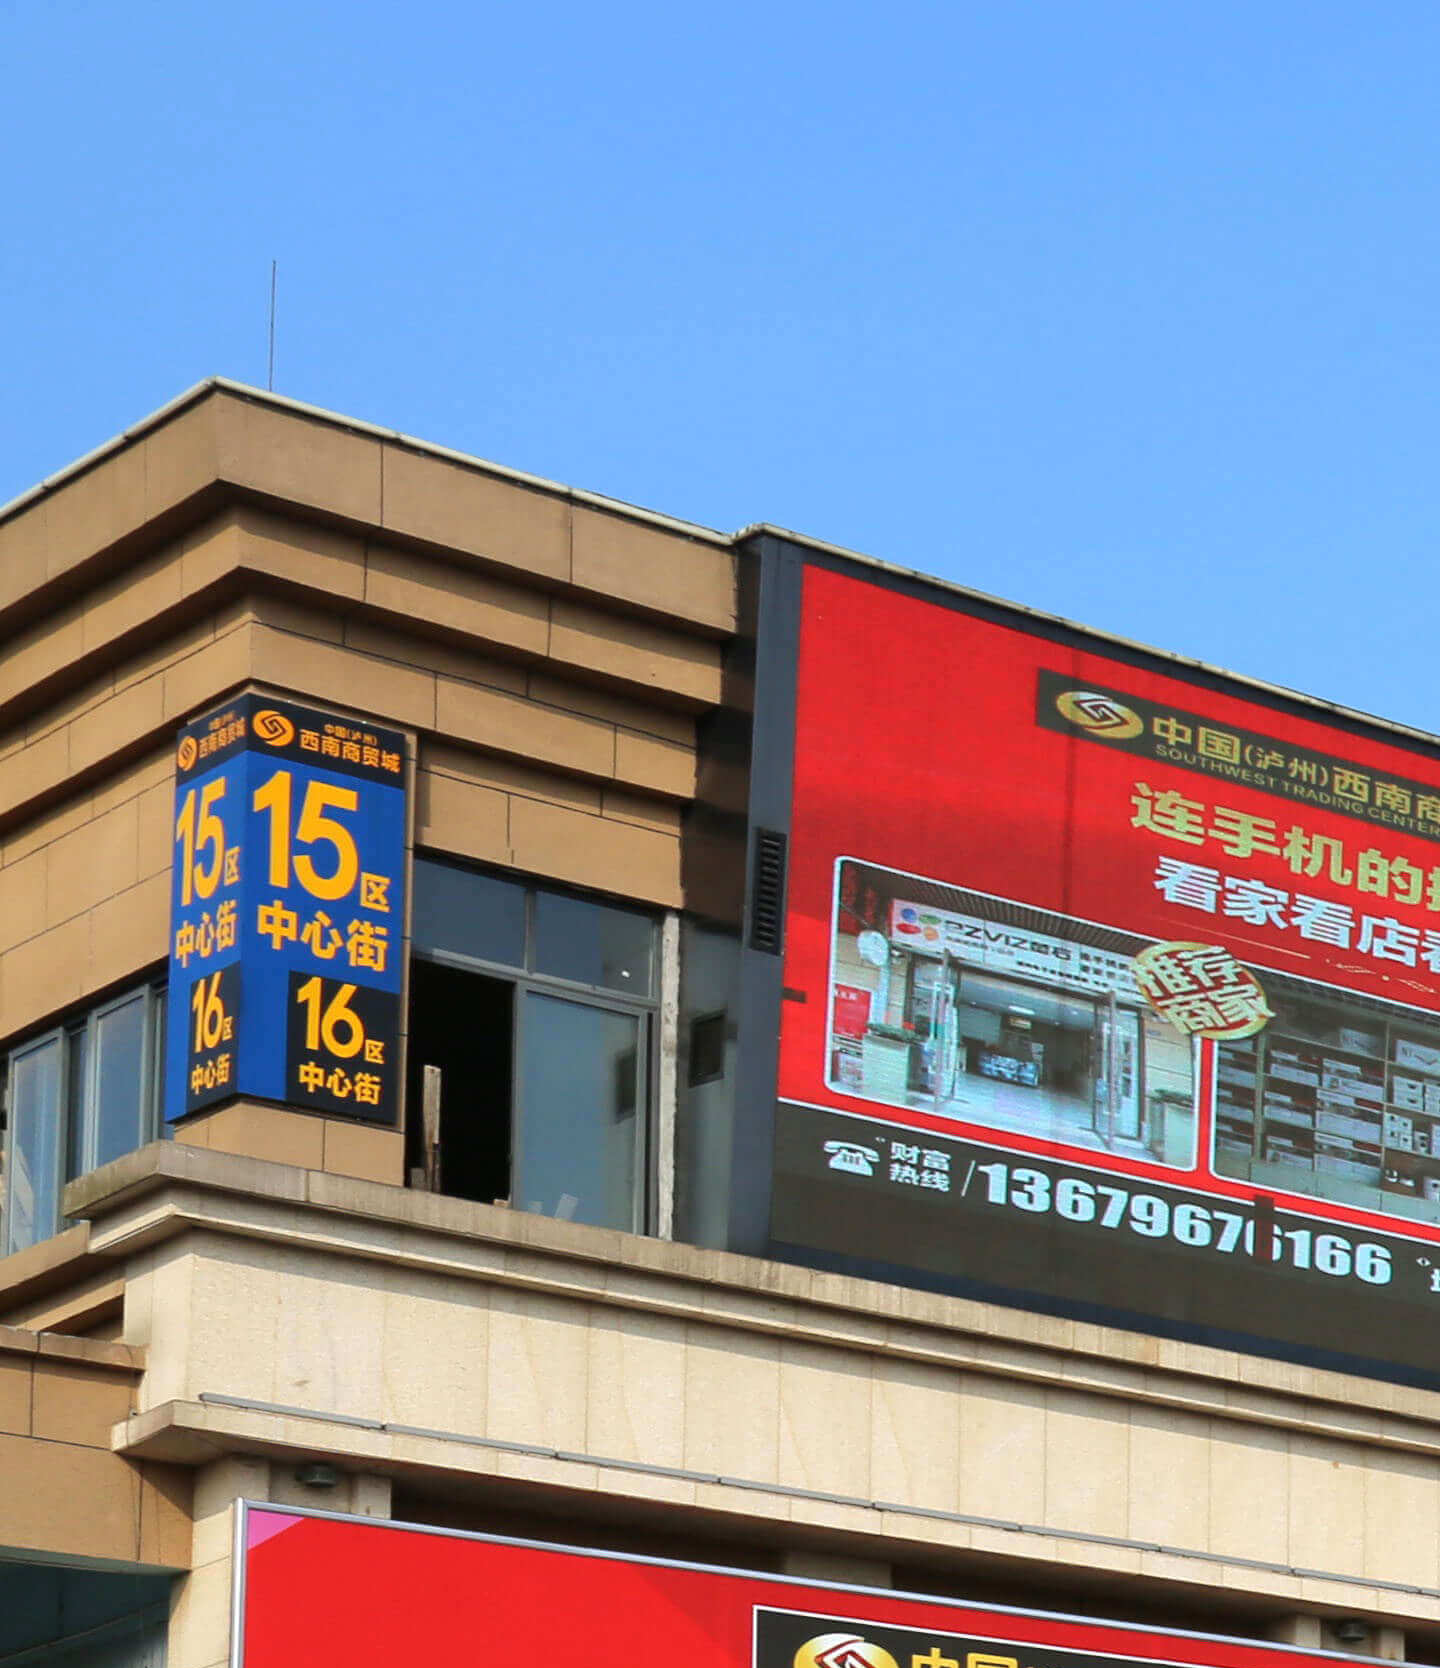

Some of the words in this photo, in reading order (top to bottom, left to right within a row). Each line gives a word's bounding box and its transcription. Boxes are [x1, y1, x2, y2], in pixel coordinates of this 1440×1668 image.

[299, 729, 400, 773] 西南商贸城
[1156, 743, 1276, 789] SOUTHWEST
[1280, 780, 1363, 814] TRADING
[176, 776, 239, 906] 15区
[253, 771, 390, 914] 15区
[175, 902, 236, 968] 中心街
[256, 902, 387, 973] 中心街
[1129, 945, 1239, 997] 推荐
[191, 973, 232, 1052] 16区
[297, 975, 384, 1064] 16区
[1157, 983, 1275, 1035] 商家
[191, 1053, 229, 1090] 中心街
[298, 1060, 380, 1105] 中心街
[889, 1164, 950, 1193] 热线
[891, 1141, 952, 1172] 财富
